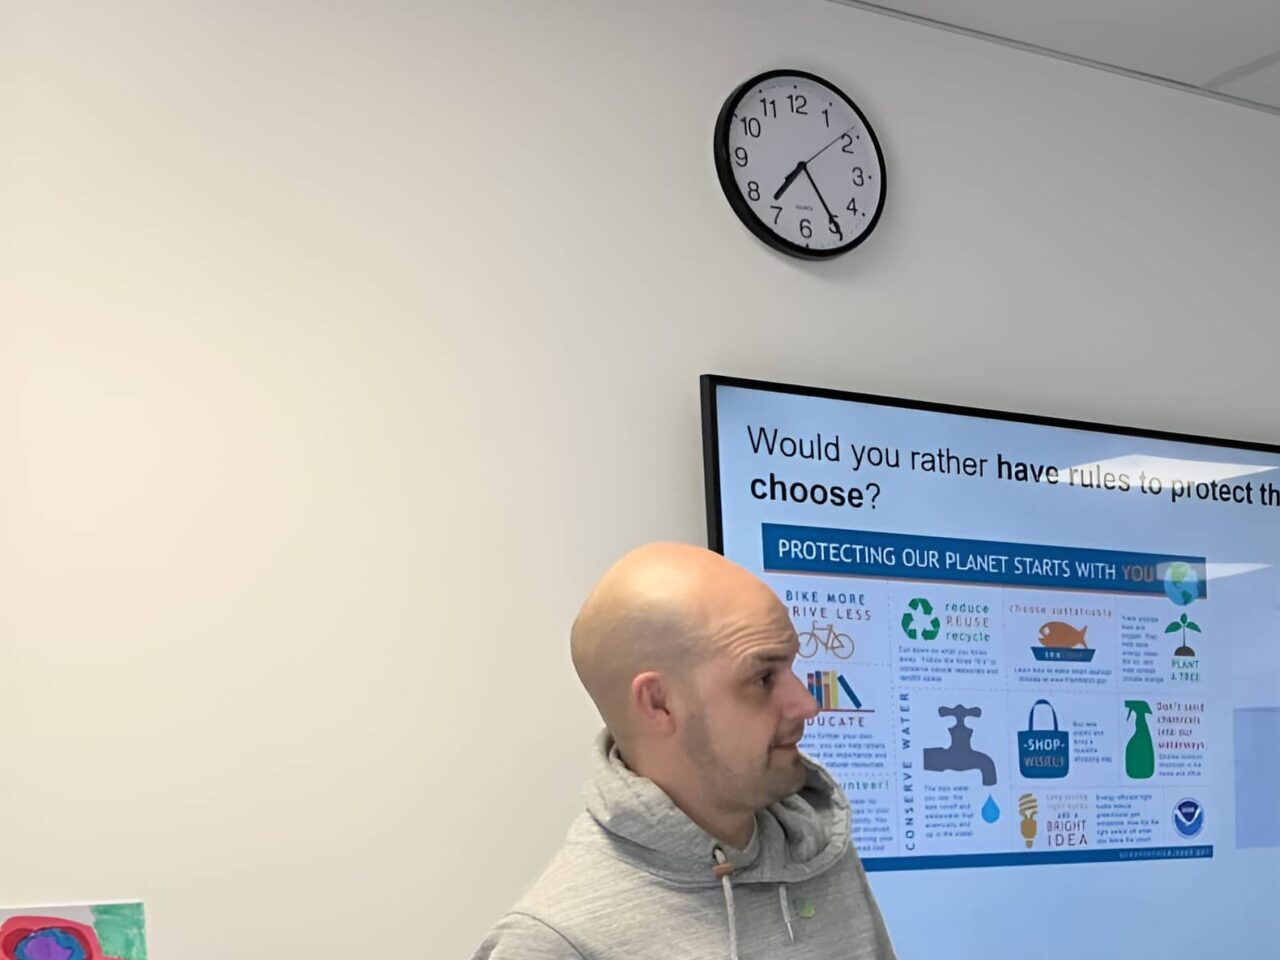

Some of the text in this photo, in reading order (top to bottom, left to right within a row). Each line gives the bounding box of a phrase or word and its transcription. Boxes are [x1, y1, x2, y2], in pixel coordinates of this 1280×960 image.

[760, 98, 777, 118] 11
[787, 95, 808, 115] 12
[740, 117, 761, 138] 10
[841, 133, 854, 154] 2
[735, 147, 748, 167] 9
[852, 167, 865, 187] 3
[748, 181, 761, 201] 8
[770, 205, 783, 224] 7
[846, 198, 858, 216] 4
[800, 218, 813, 238] 6
[747, 425, 840, 462] Would
[851, 443, 899, 472] you
[911, 448, 988, 478] rather
[997, 453, 1059, 485] have
[1068, 464, 1131, 492] rules
[1139, 468, 1163, 496] to
[1171, 478, 1253, 505] protect
[750, 472, 881, 509] choose?
[778, 538, 896, 567] PROTECTING
[902, 548, 940, 569] OUR
[945, 551, 1008, 574] PLANET
[1014, 557, 1070, 577] STARTS
[1075, 562, 1116, 580] WITH
[786, 590, 865, 606] BIKE MORE
[945, 602, 989, 613] reduce
[787, 606, 872, 621] RIVE LESS
[946, 631, 990, 643] recycle
[804, 717, 864, 727] DUCATE
[901, 693, 915, 850] CONSERVE WATER
[1046, 820, 1086, 832] BRIGHT
[1048, 834, 1087, 847] IDEA
